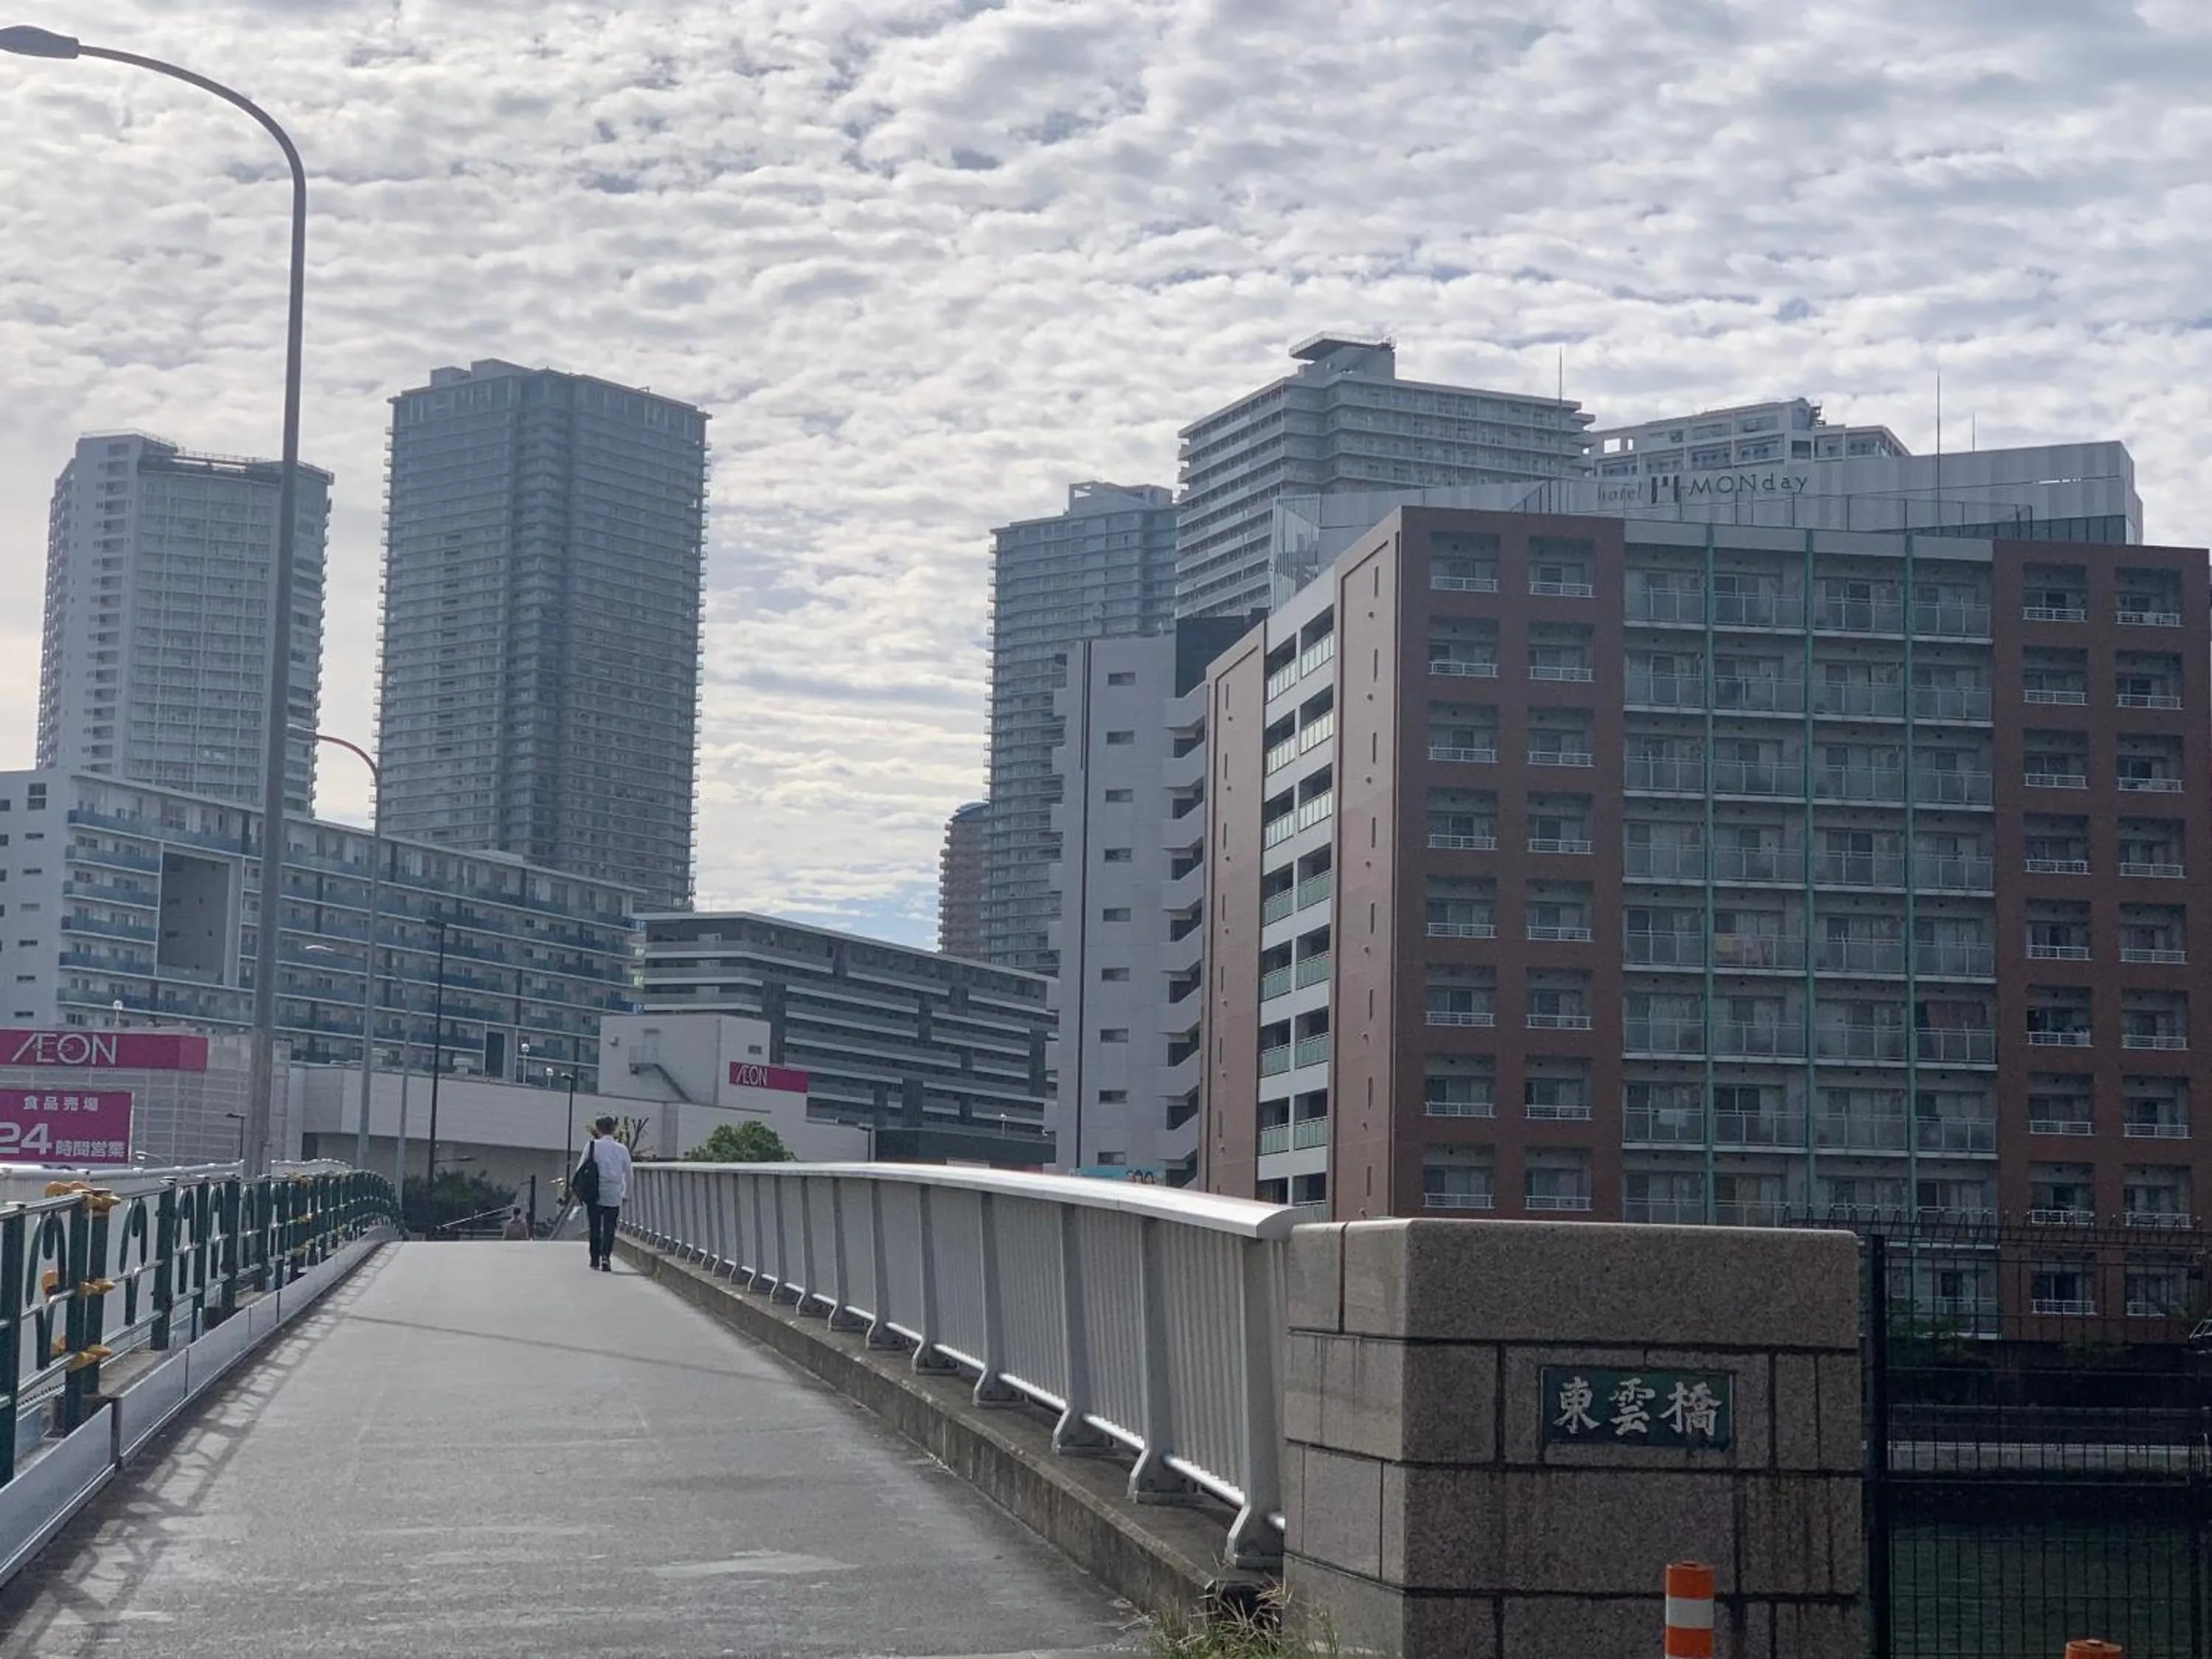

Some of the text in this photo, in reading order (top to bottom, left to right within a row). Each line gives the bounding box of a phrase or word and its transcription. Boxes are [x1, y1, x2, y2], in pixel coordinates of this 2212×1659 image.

[23, 1095, 99, 1112] 食品売場
[1553, 1376, 1722, 1436] 東雲橋
